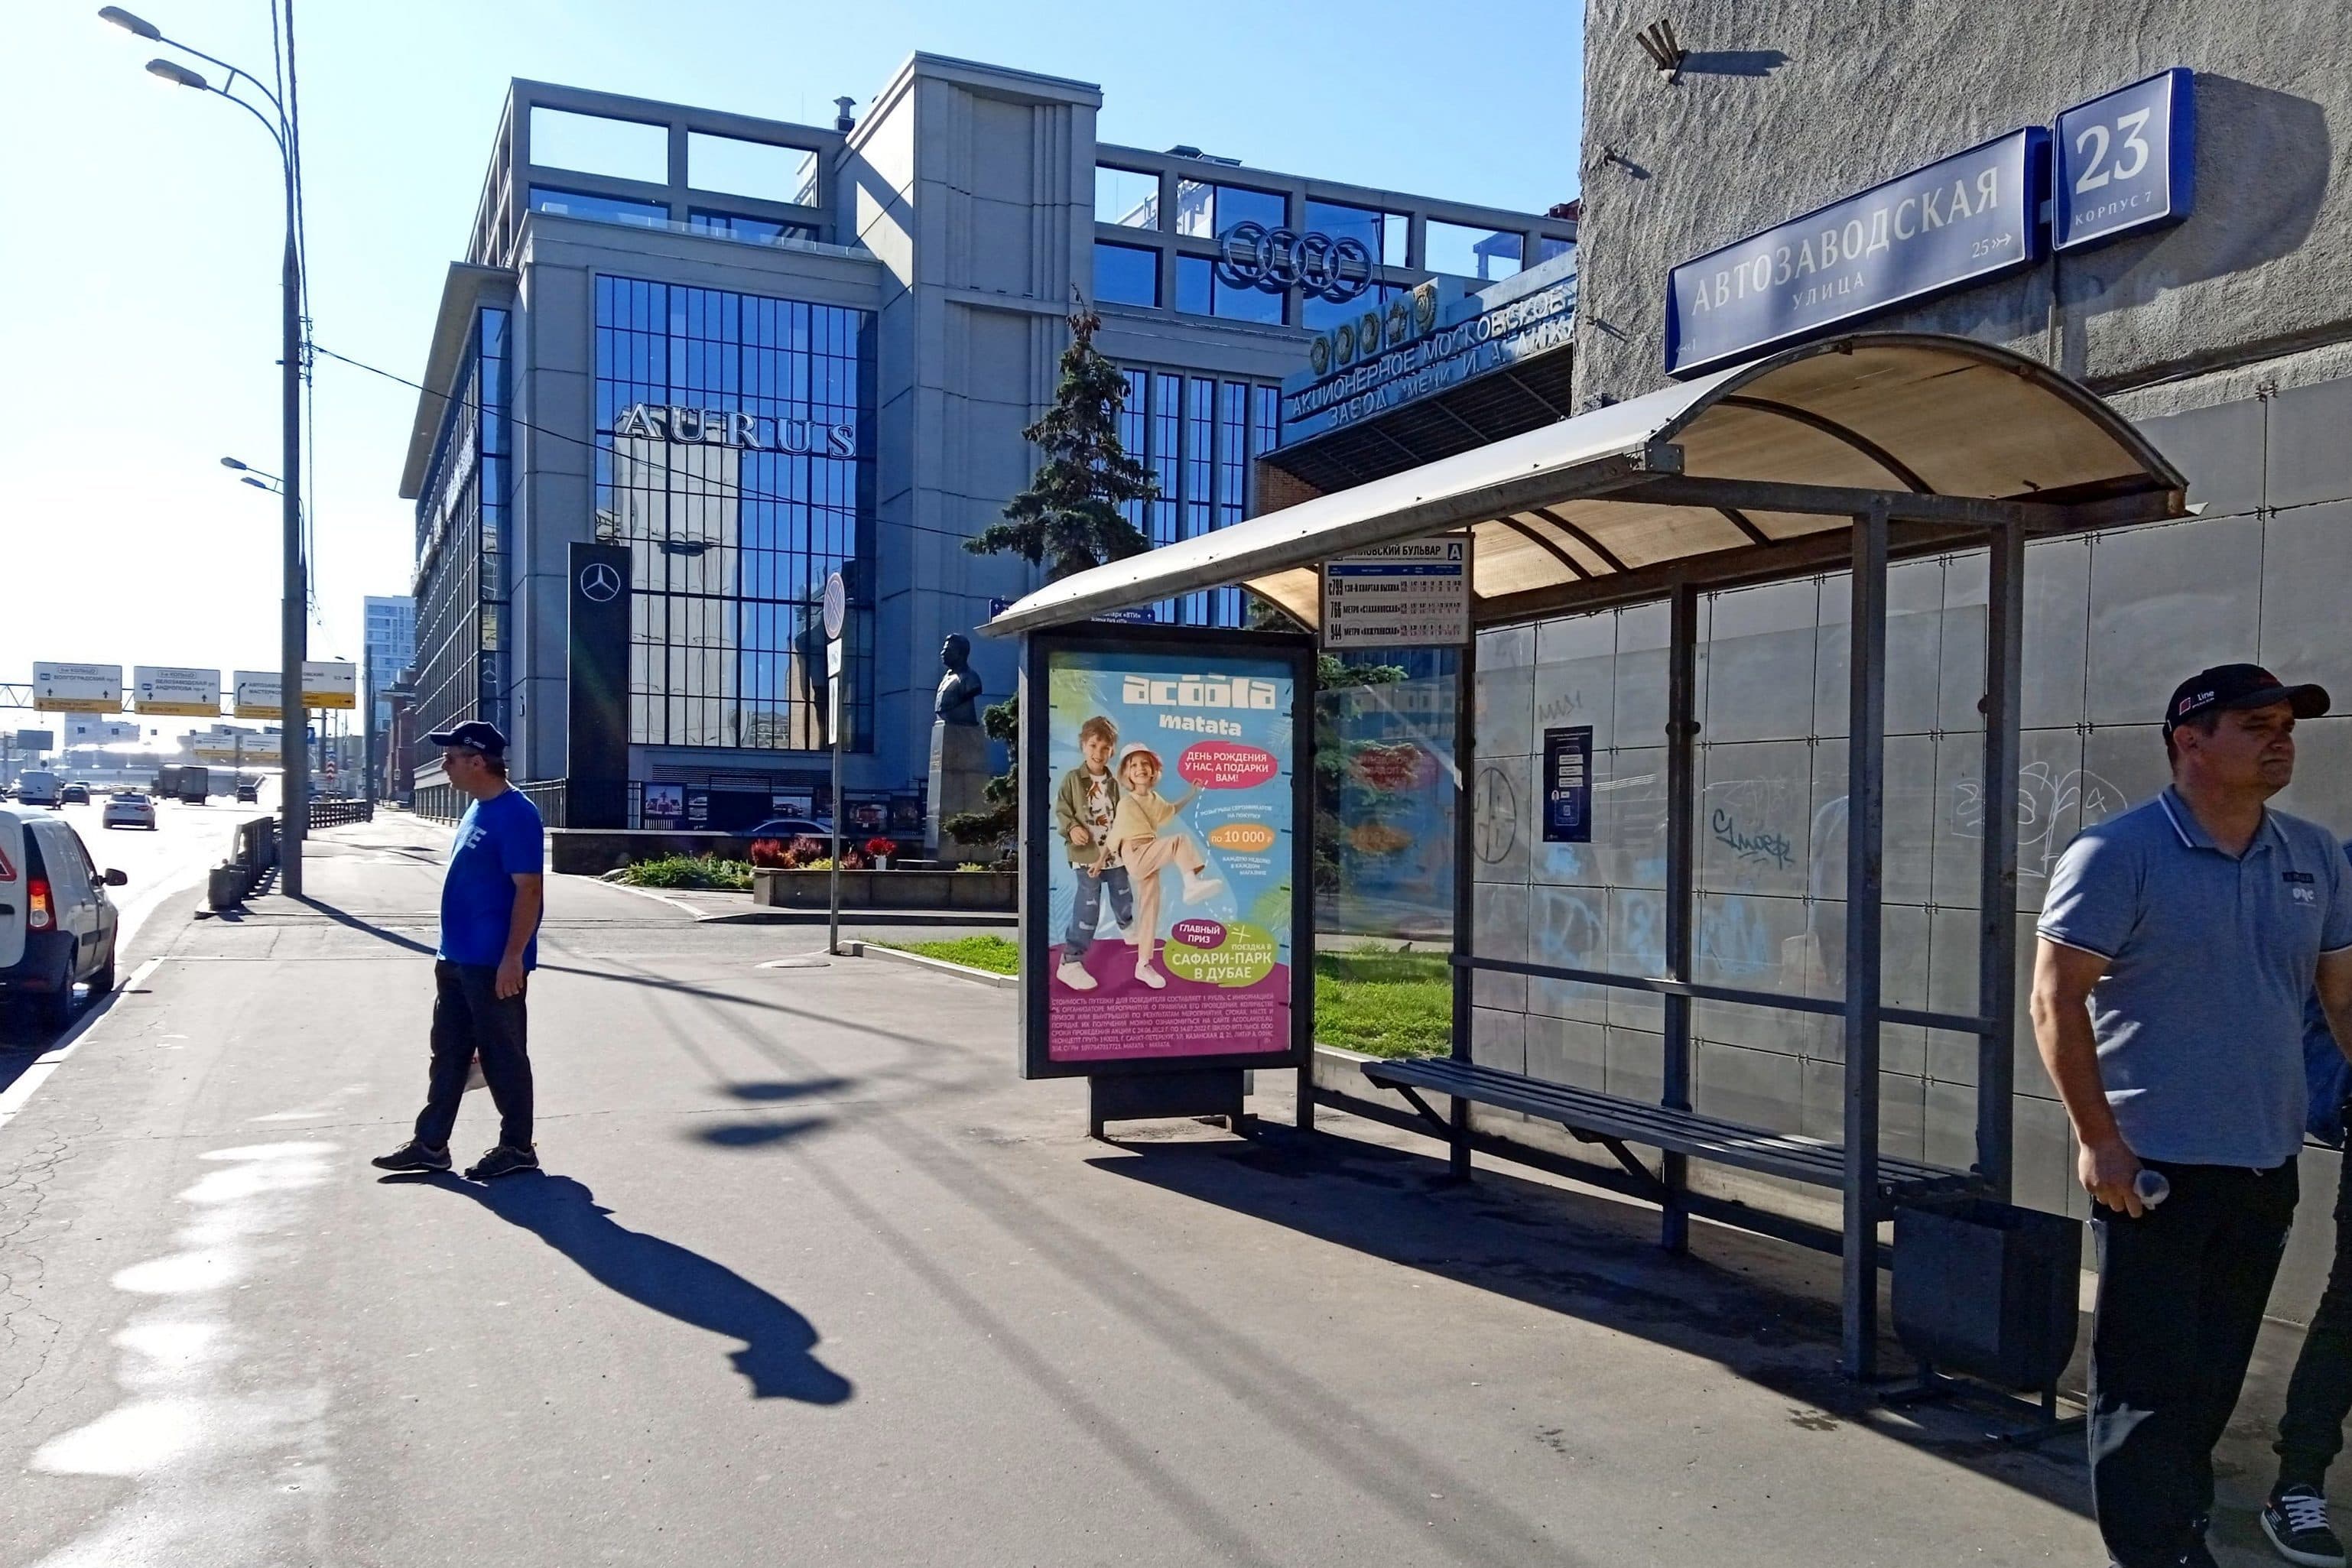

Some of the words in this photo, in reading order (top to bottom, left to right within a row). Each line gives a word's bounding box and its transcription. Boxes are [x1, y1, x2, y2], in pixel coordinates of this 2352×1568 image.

[2076, 107, 2150, 195] 23
[2074, 194, 2139, 226] КОРПУС
[2145, 191, 2152, 203] 7
[1691, 165, 2000, 317] АВТОЗАВОДСКАЯ
[1971, 238, 1990, 260] 25
[1792, 271, 1866, 312] УЛИЦА
[1292, 347, 1415, 416] АКЦИОНЕРНОЕ
[1327, 385, 1388, 427] ЗАВОД
[1463, 351, 1480, 377] И.
[616, 401, 856, 460] AURUS
[1402, 545, 1441, 557] БУЛЬВАР
[1449, 544, 1461, 560] А
[1330, 601, 1342, 618] 766
[1343, 605, 1360, 614] МЕТРО
[1330, 623, 1342, 641] 944
[1344, 628, 1360, 636] МЕТРО
[1122, 673, 1276, 710] acoola
[1159, 713, 1242, 736] matata
[1187, 752, 1212, 761] ДЕНЬ
[1213, 752, 1267, 762] РОЖДЕНИЯ
[1184, 762, 1193, 771] У
[1193, 763, 1214, 772] НАС,
[1215, 763, 1222, 771] А
[1223, 763, 1269, 773] ПОДАРКИ
[1215, 774, 1239, 782] ВАМ!
[1223, 831, 1239, 842] 10
[1242, 831, 1265, 842] 000
[1179, 924, 1221, 935] ГЛАВНЫЙ
[1187, 934, 1210, 943] ПРИЗ
[1231, 943, 1266, 952] ПОЕЗДКА
[1172, 952, 1272, 965] САФАРИ-ПАРК
[1194, 967, 1203, 979] В
[1206, 966, 1252, 982] ДУБАЕ
